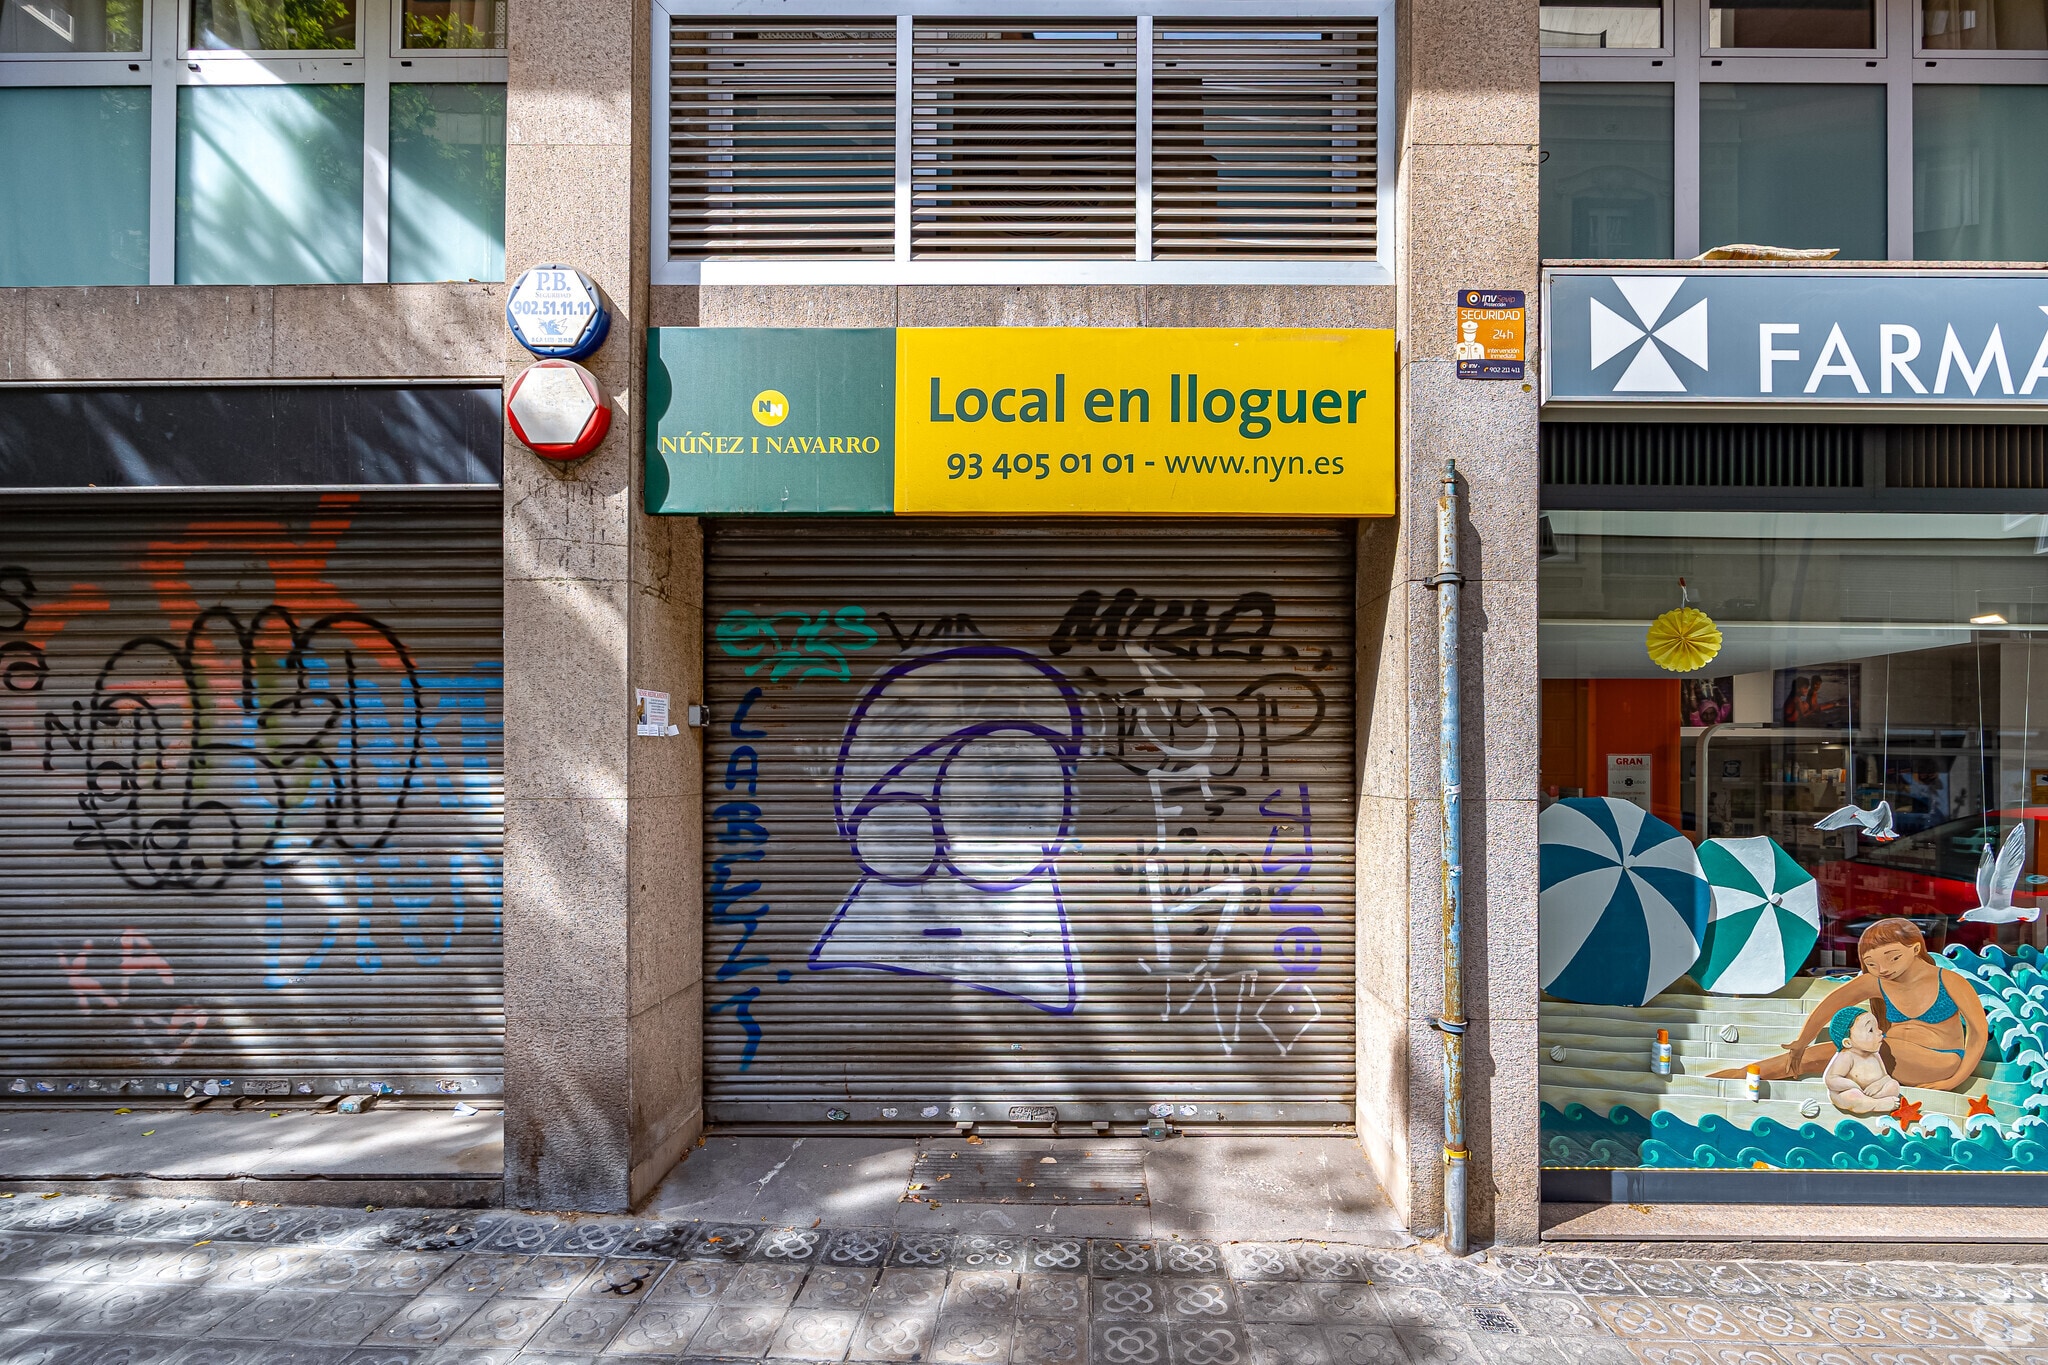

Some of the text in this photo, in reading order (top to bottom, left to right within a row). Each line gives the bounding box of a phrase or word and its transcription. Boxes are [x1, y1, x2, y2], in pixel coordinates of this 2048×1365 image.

[536, 271, 572, 291] P.B.
[513, 300, 590, 316] 902.51.11.11
[1460, 310, 1520, 320] SEGURIDAD
[930, 373, 1367, 440] Local en lloguer
[661, 431, 881, 455] NÚÑEZ I NAVARRO
[946, 453, 983, 481] 93
[992, 453, 1051, 481] 405
[1060, 453, 1092, 474] 01
[1102, 453, 1135, 474] 01
[1164, 453, 1345, 483] www.nyn.es
